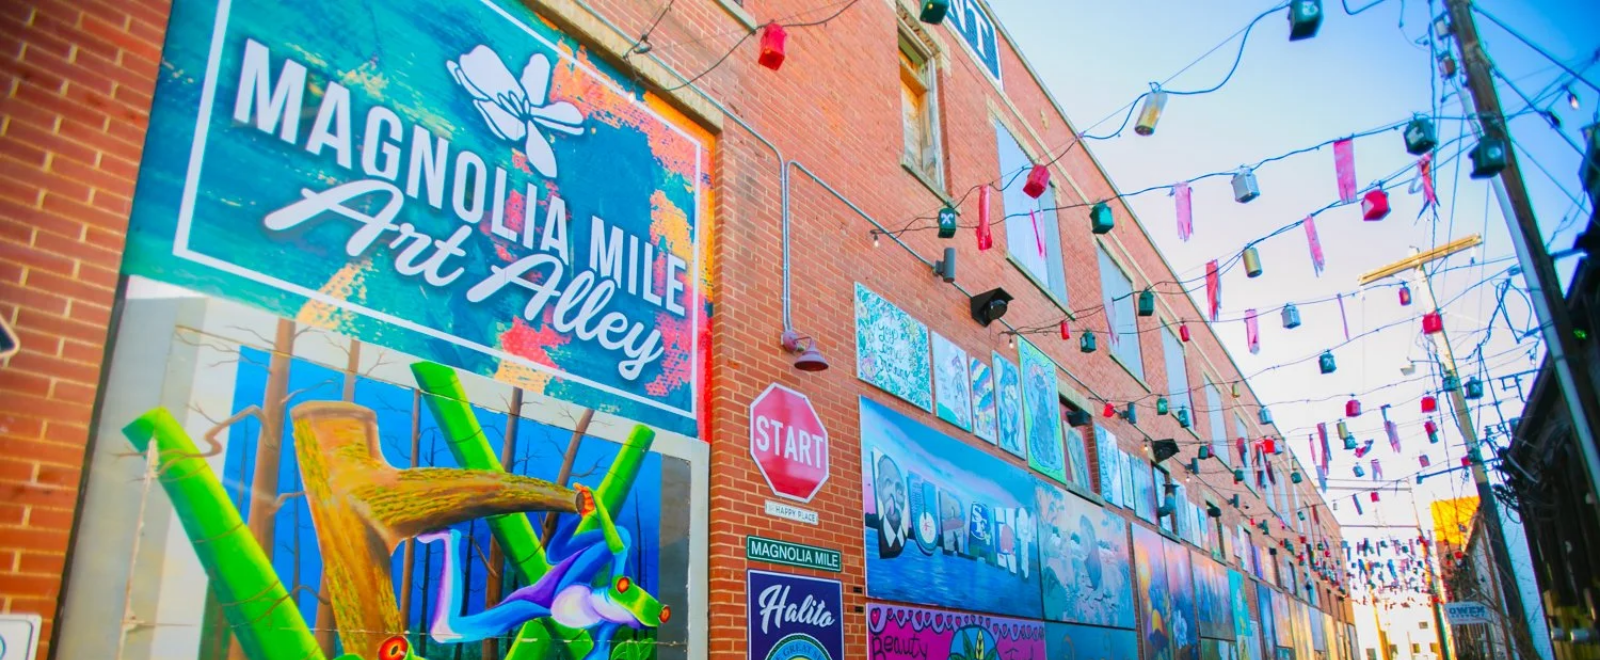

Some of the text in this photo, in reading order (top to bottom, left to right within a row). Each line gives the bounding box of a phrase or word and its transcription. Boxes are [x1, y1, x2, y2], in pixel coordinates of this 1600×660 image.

[233, 38, 687, 316] MAGNOLIA MILE
[264, 180, 664, 380] Art Alley
[756, 415, 823, 469] START
[775, 505, 796, 516] HAPPY
[798, 510, 815, 523] PLACE
[751, 541, 838, 567] MAGNOLIA MILE
[758, 584, 835, 634] Halito
[871, 636, 928, 660] Beauty
